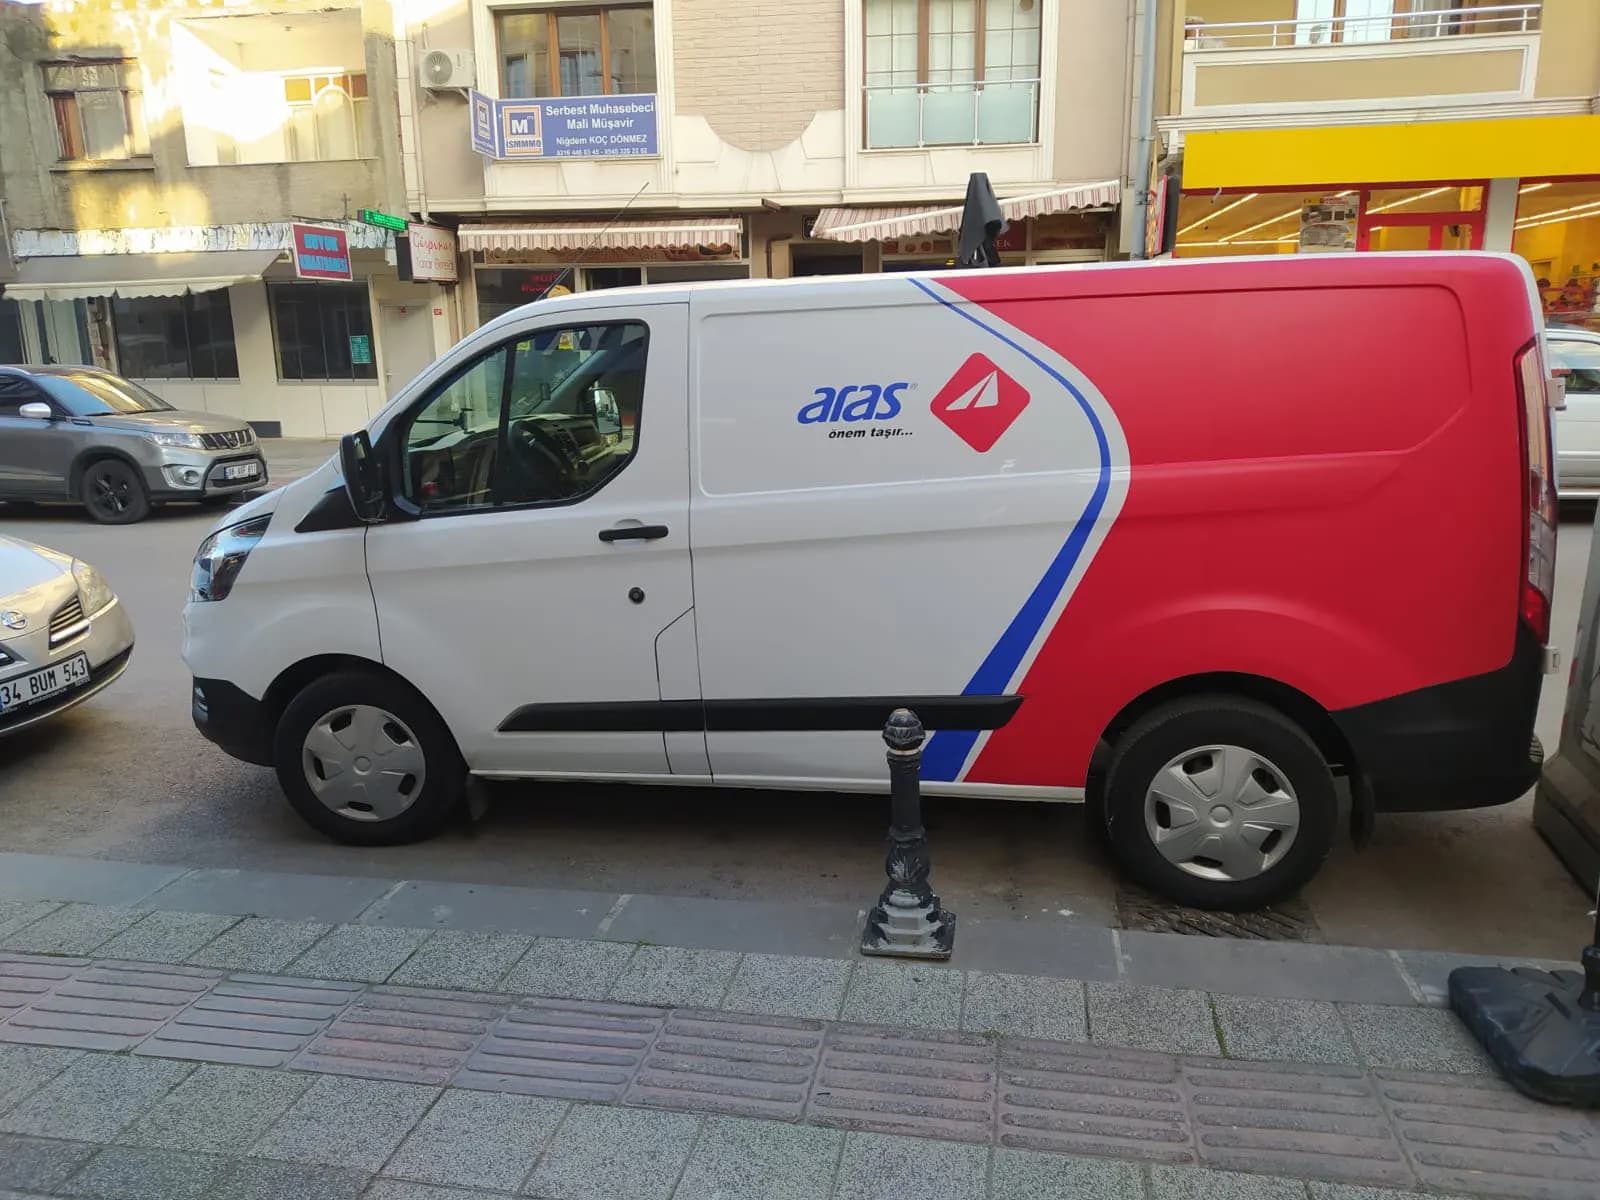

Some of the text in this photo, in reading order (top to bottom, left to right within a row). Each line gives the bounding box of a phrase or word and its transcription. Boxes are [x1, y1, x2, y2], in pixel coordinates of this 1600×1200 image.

[546, 102, 655, 116] Serbest Muhasebeci
[567, 118, 635, 131] Mali Müşavir
[589, 135, 609, 146] KOÇ
[610, 134, 648, 144] DÖNMEZ
[797, 382, 909, 424] aras
[828, 427, 913, 439] önem taşır...
[1, 682, 21, 705] 34
[29, 669, 57, 695] BUM
[63, 658, 86, 682] 543
